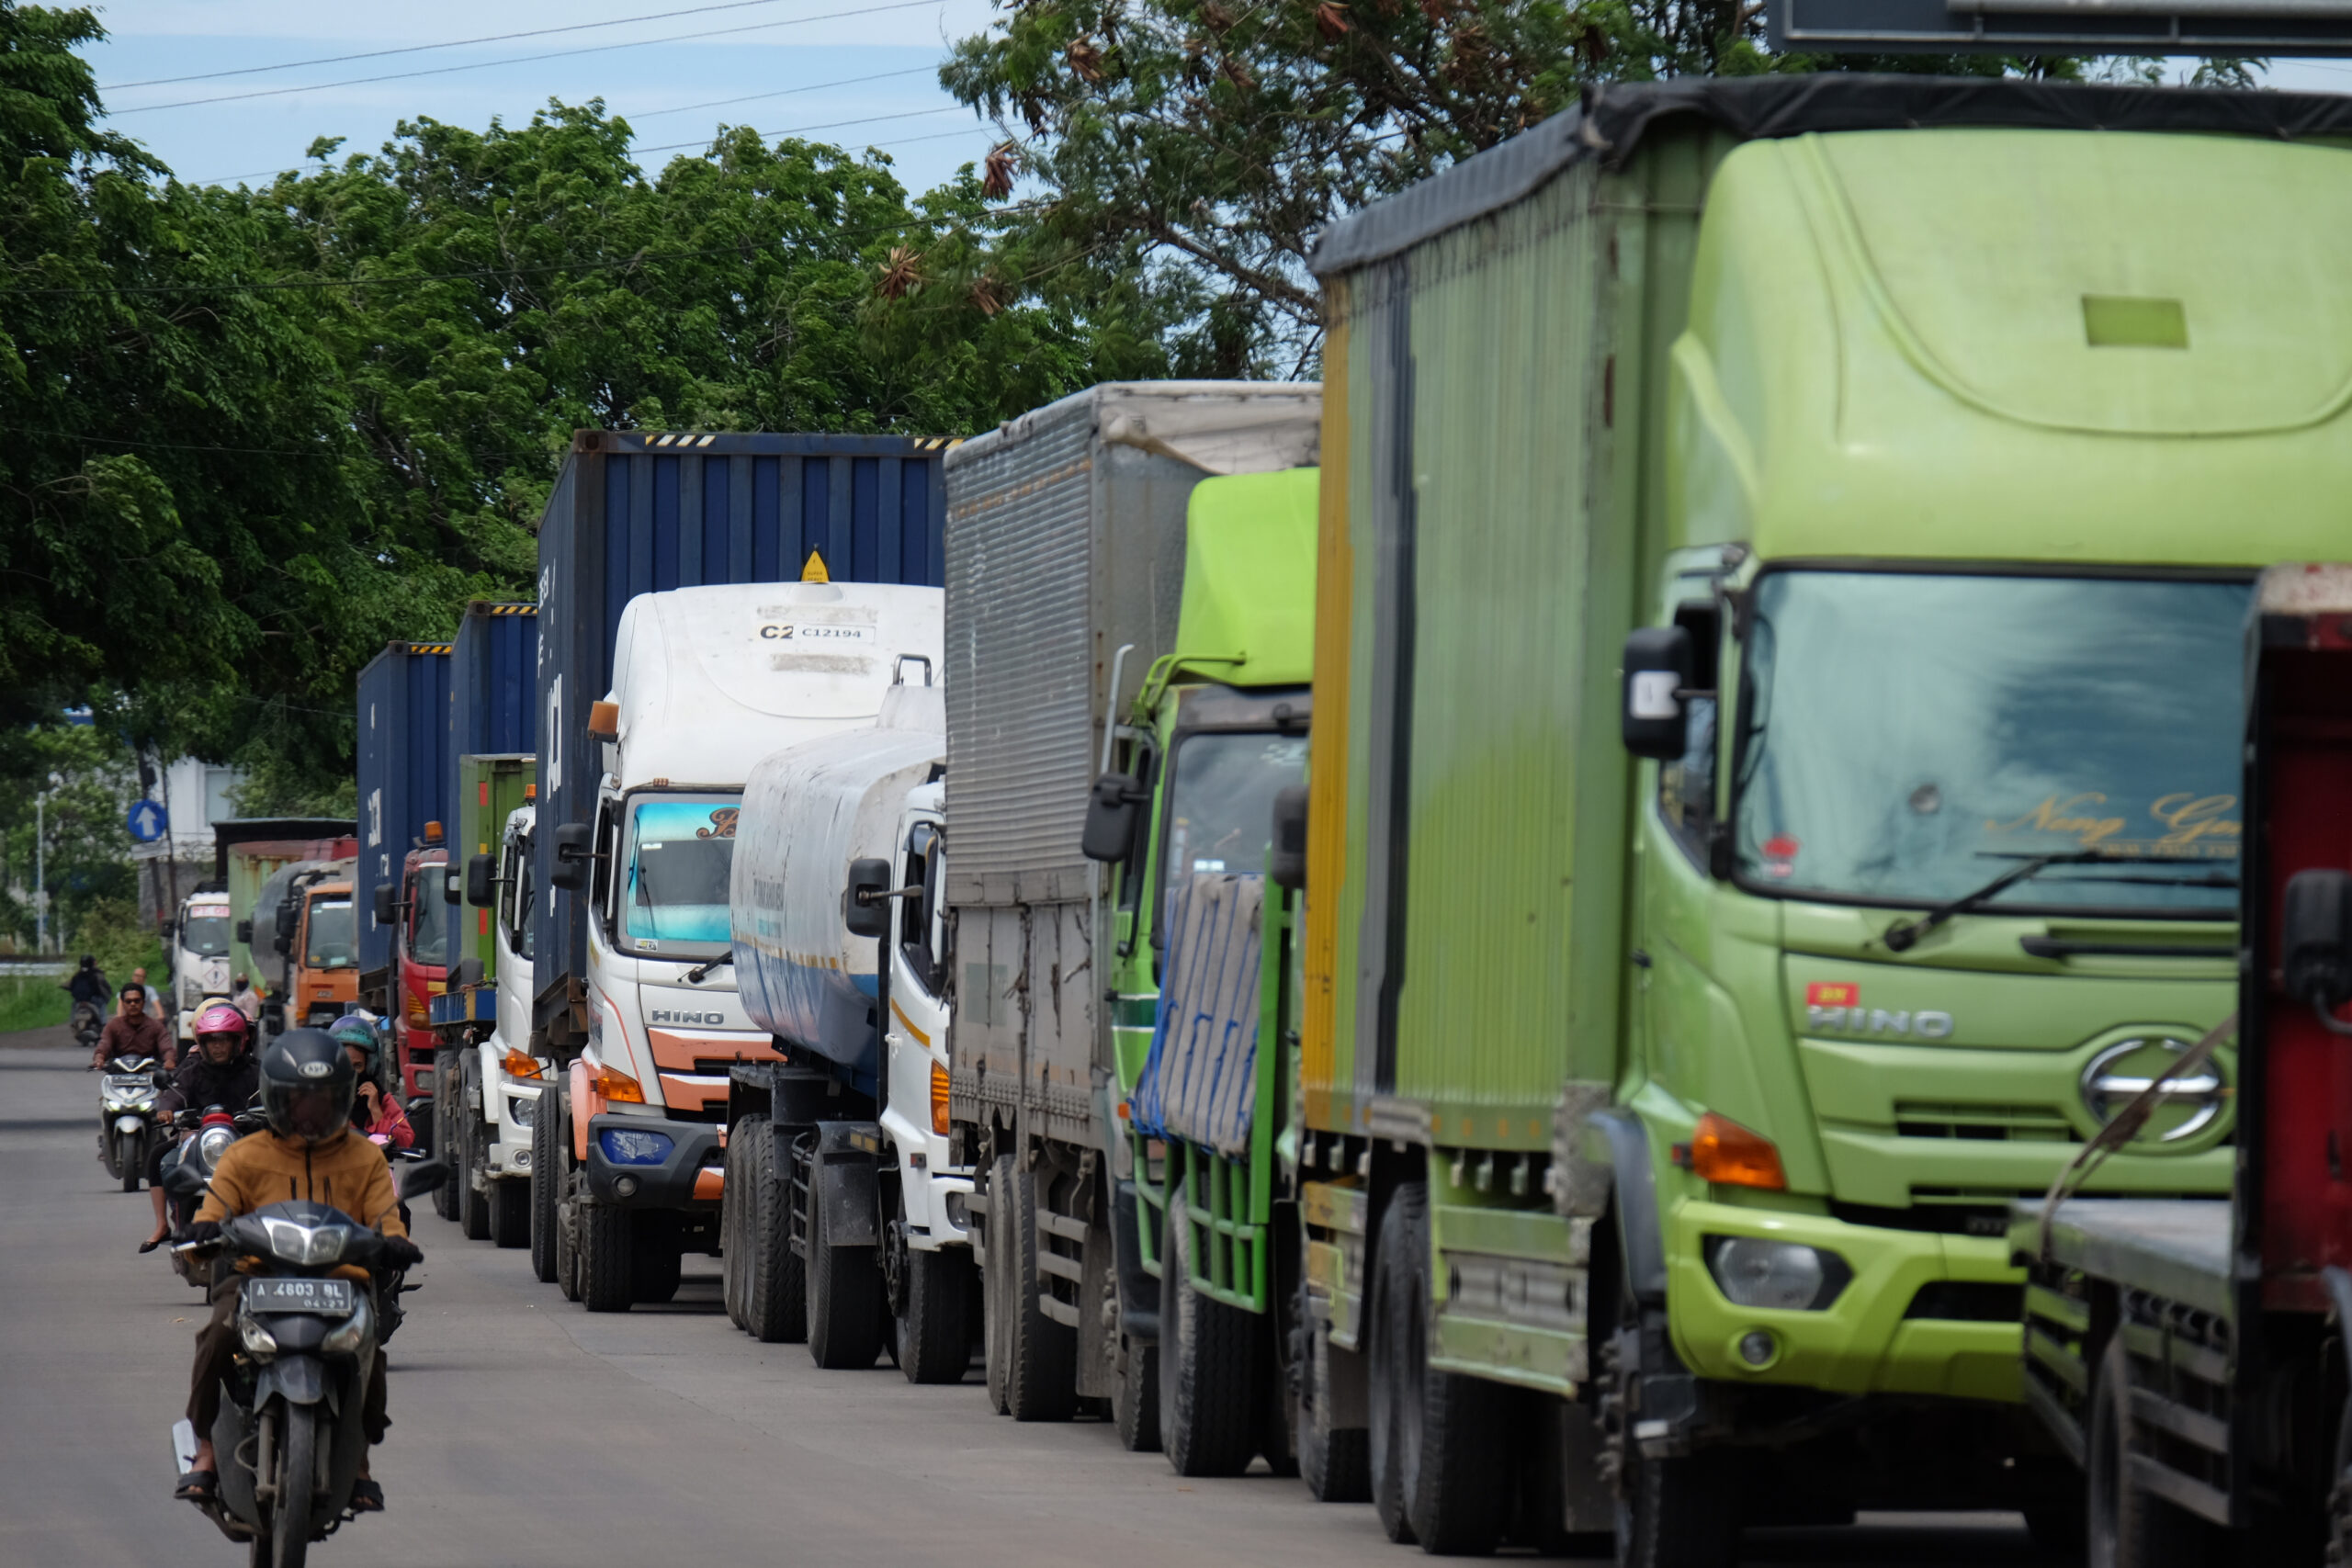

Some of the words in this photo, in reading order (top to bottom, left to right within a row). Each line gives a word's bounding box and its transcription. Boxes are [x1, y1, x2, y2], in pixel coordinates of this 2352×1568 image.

[801, 628, 862, 638] C12194
[651, 1009, 724, 1025] HINO
[1807, 1005, 1955, 1039] HINO
[257, 1283, 266, 1296] A
